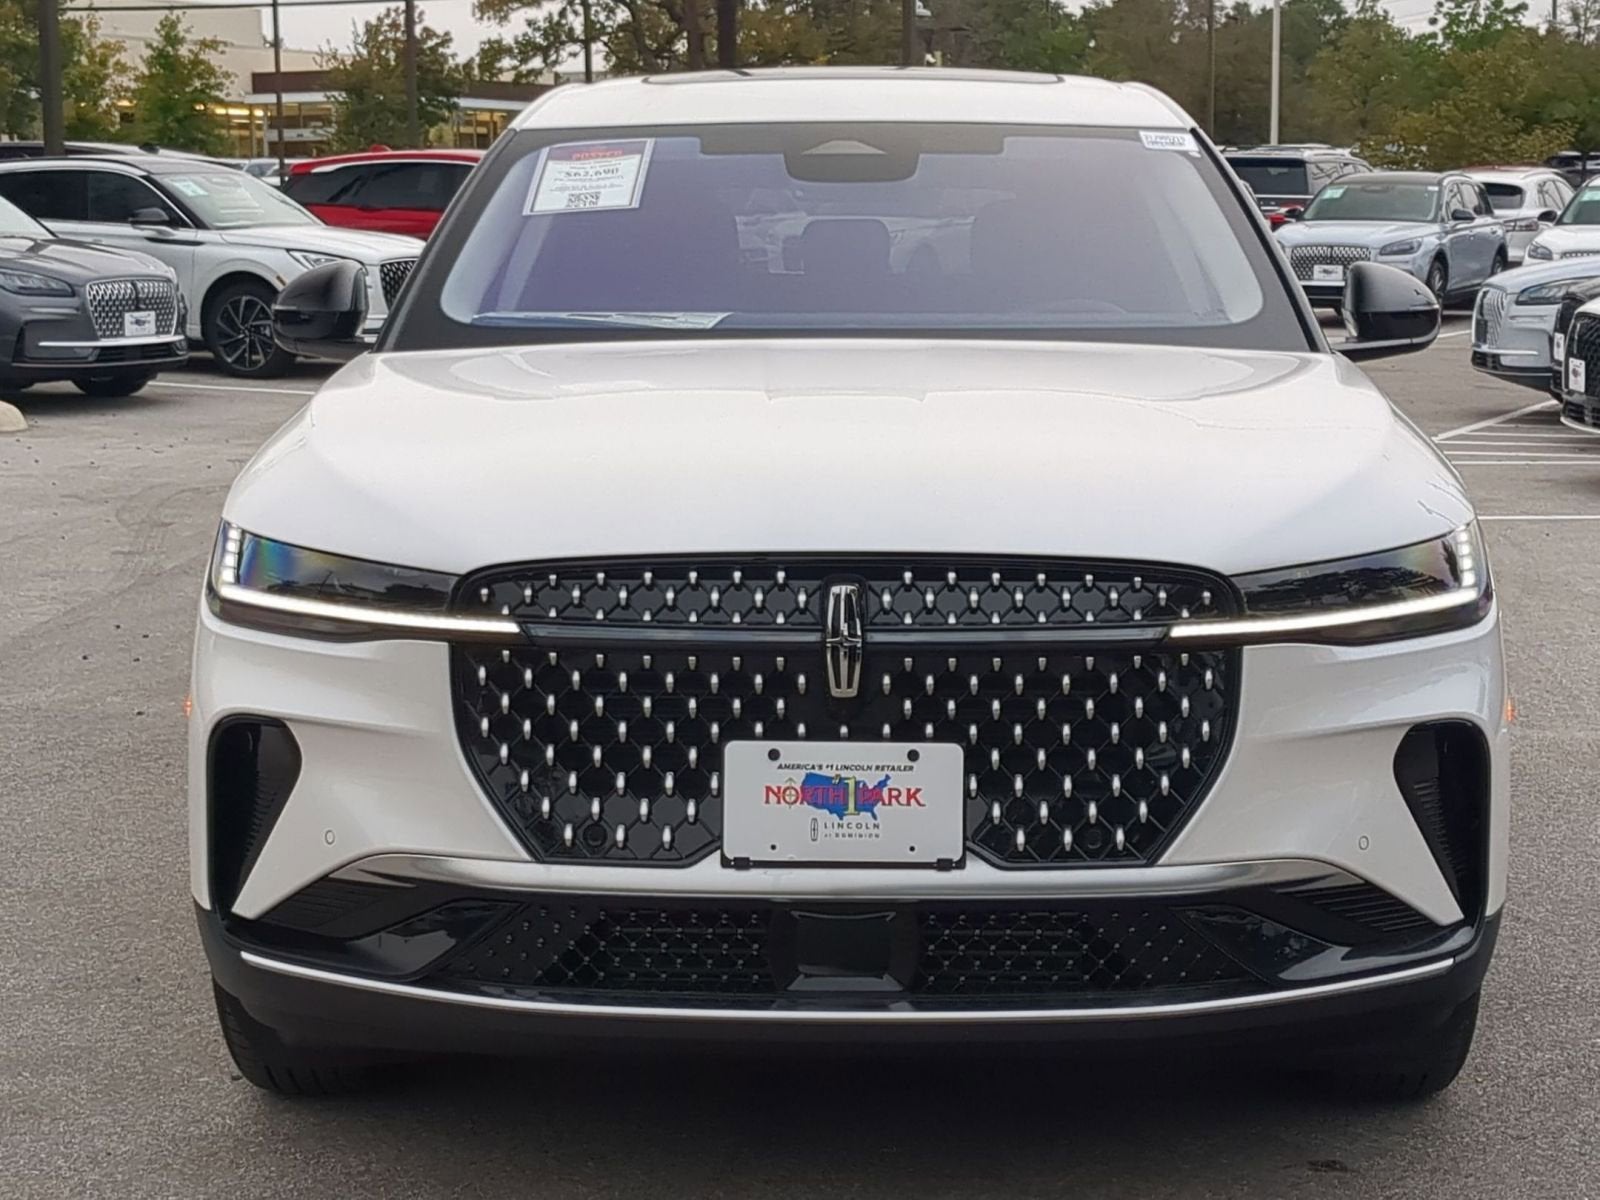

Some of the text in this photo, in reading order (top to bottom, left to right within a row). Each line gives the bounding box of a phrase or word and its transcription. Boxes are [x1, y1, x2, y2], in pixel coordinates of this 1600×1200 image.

[777, 763, 823, 771] AMERICA'S
[835, 764, 872, 772] LINCOLN
[764, 785, 926, 807] NORTH PARK
[823, 822, 880, 830] LINCOLN
